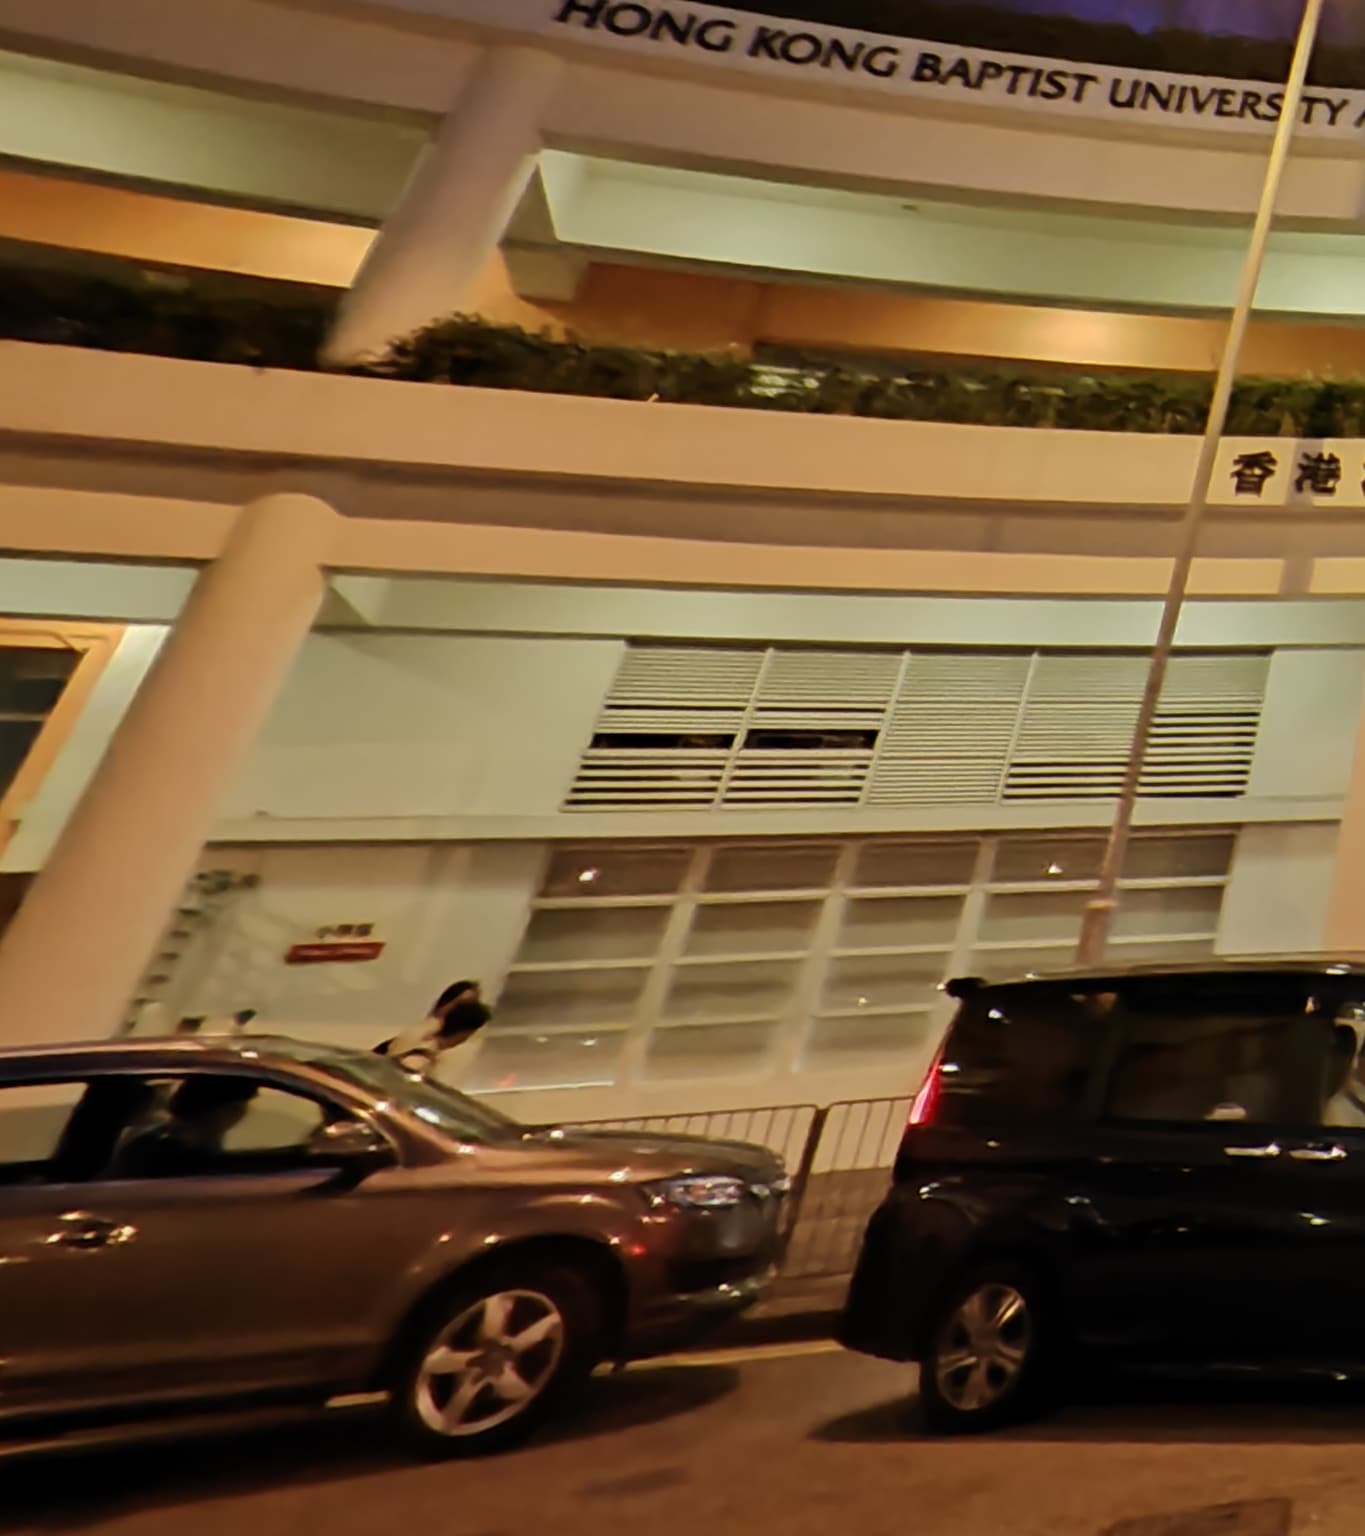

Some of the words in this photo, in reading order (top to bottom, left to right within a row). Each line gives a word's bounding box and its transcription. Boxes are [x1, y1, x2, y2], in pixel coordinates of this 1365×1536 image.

[746, 25, 900, 78] KONG
[911, 51, 1099, 103] BAPTIST
[1108, 78, 1349, 127] UNIVERSTY
